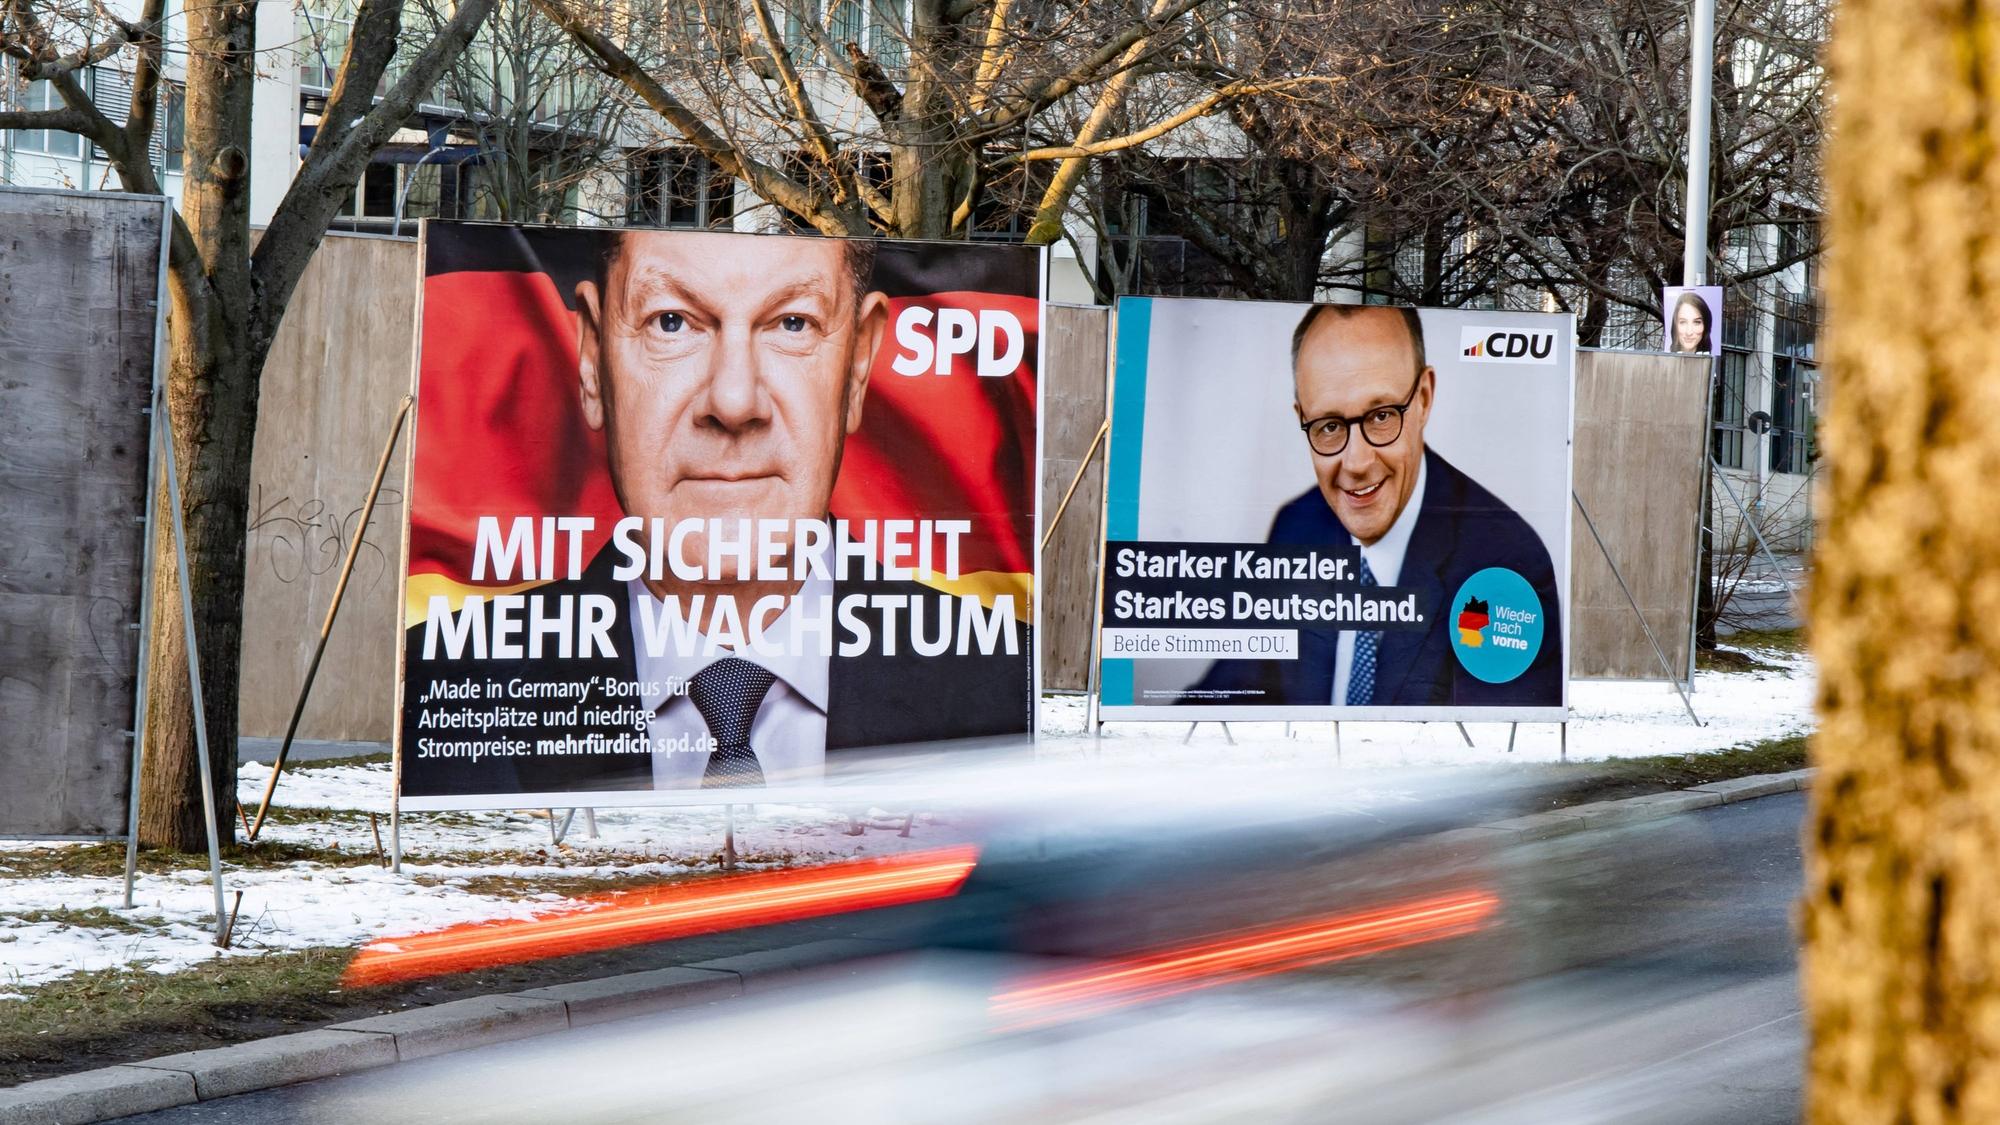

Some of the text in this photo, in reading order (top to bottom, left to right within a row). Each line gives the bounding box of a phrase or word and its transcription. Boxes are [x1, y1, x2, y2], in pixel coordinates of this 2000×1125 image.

[892, 306, 1024, 376] SPD
[1486, 333, 1553, 358] CDU
[471, 516, 595, 580] MIT
[613, 516, 971, 581] SICHERHEIT
[1116, 548, 1354, 580] Starker Kanzler.
[1114, 590, 1424, 622] Starkes Deutschland.
[1495, 605, 1536, 624] Wieder
[422, 594, 1019, 660] MEHR WACHSTUM
[1493, 621, 1522, 635] nach
[1113, 634, 1289, 653] Beide Stimmen CDU.
[1492, 635, 1528, 650] vorne
[420, 676, 692, 703] „Made in Germany“-Bonus für
[418, 705, 656, 733] Arbeitsplätze und niedrige
[418, 734, 718, 762] Strompreise: mehrfürdich.spd.de
